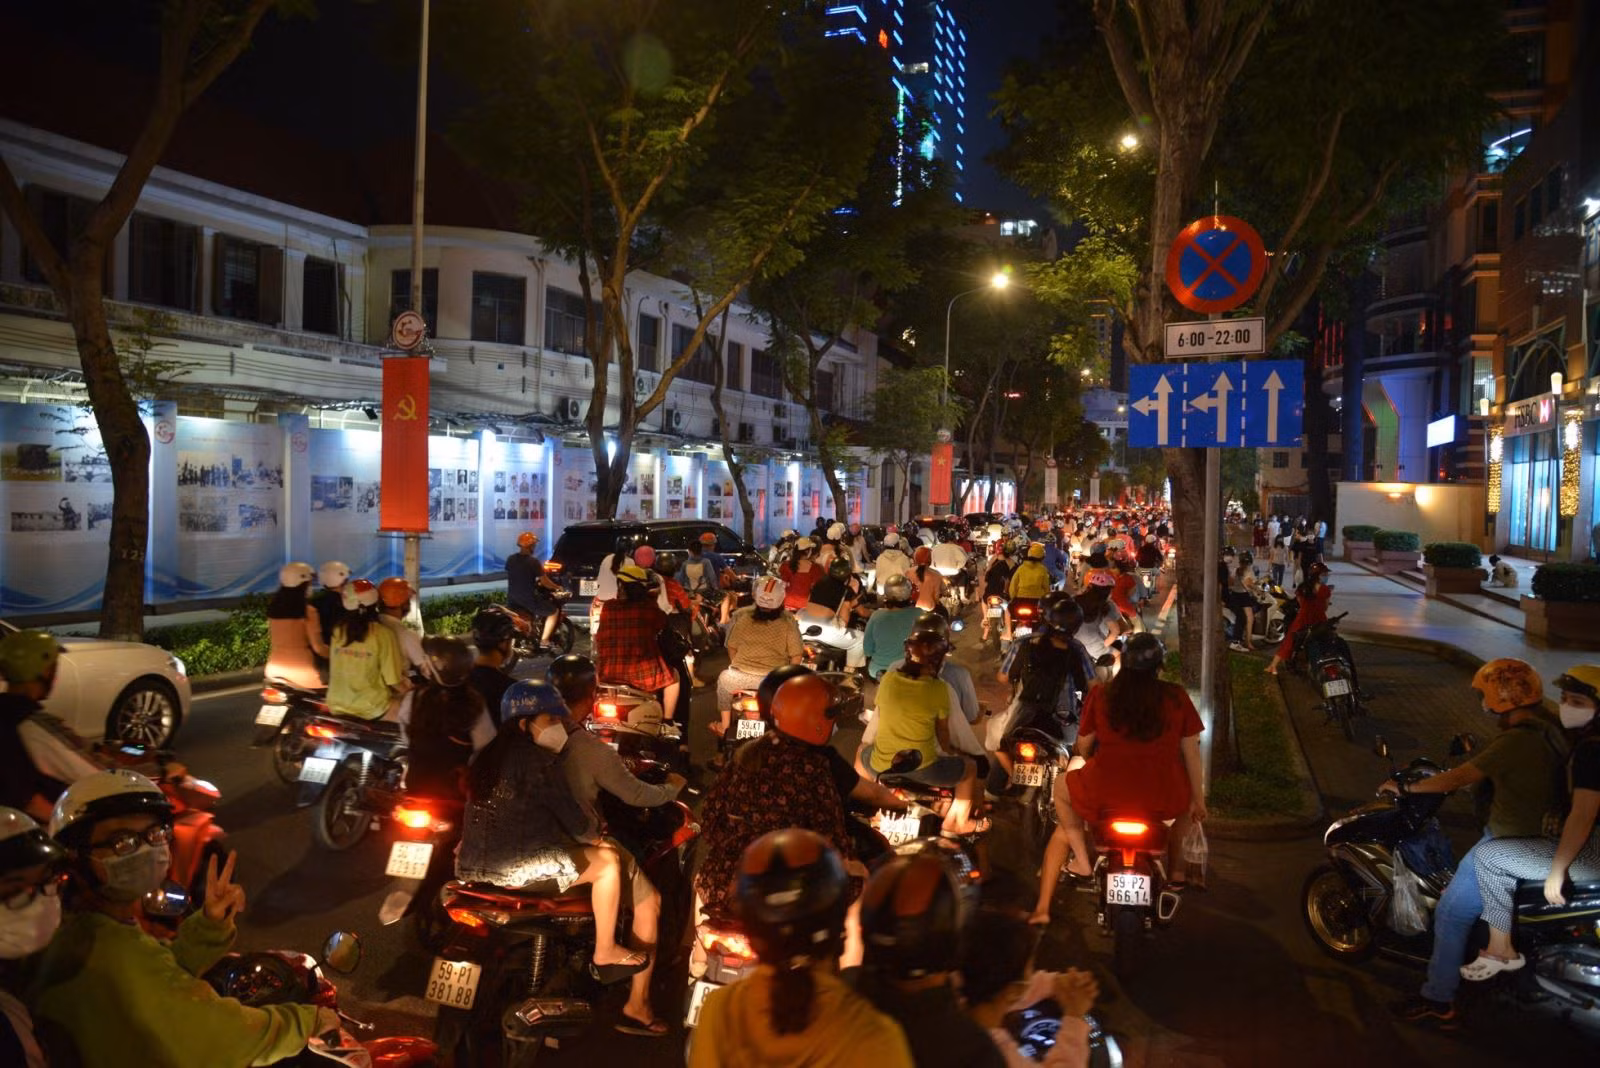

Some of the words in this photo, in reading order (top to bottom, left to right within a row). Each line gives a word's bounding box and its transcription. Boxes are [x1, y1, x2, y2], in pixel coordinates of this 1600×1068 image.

[1514, 402, 1537, 428] HSBC
[1108, 889, 1148, 904] 966.14
[428, 980, 474, 1006] 381.88
